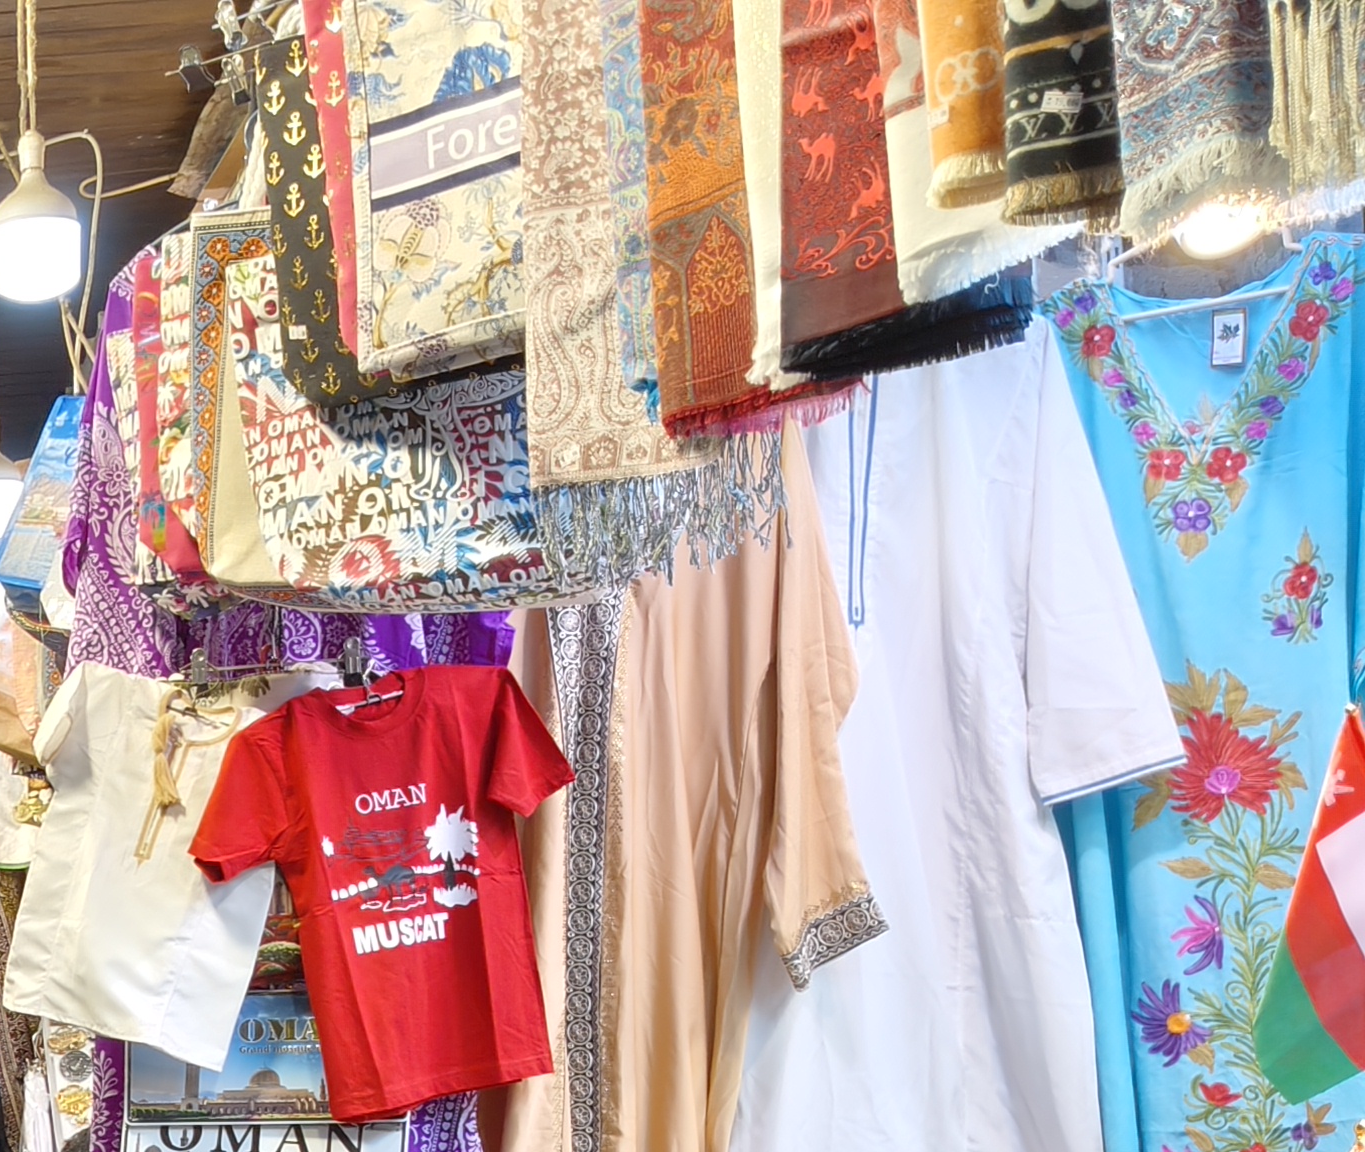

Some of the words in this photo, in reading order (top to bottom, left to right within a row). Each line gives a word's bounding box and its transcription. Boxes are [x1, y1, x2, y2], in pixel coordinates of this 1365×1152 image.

[427, 110, 522, 170] Fore
[355, 783, 426, 815] OMAN
[352, 912, 450, 955] MUSCAT
[238, 1017, 320, 1042] OMA
